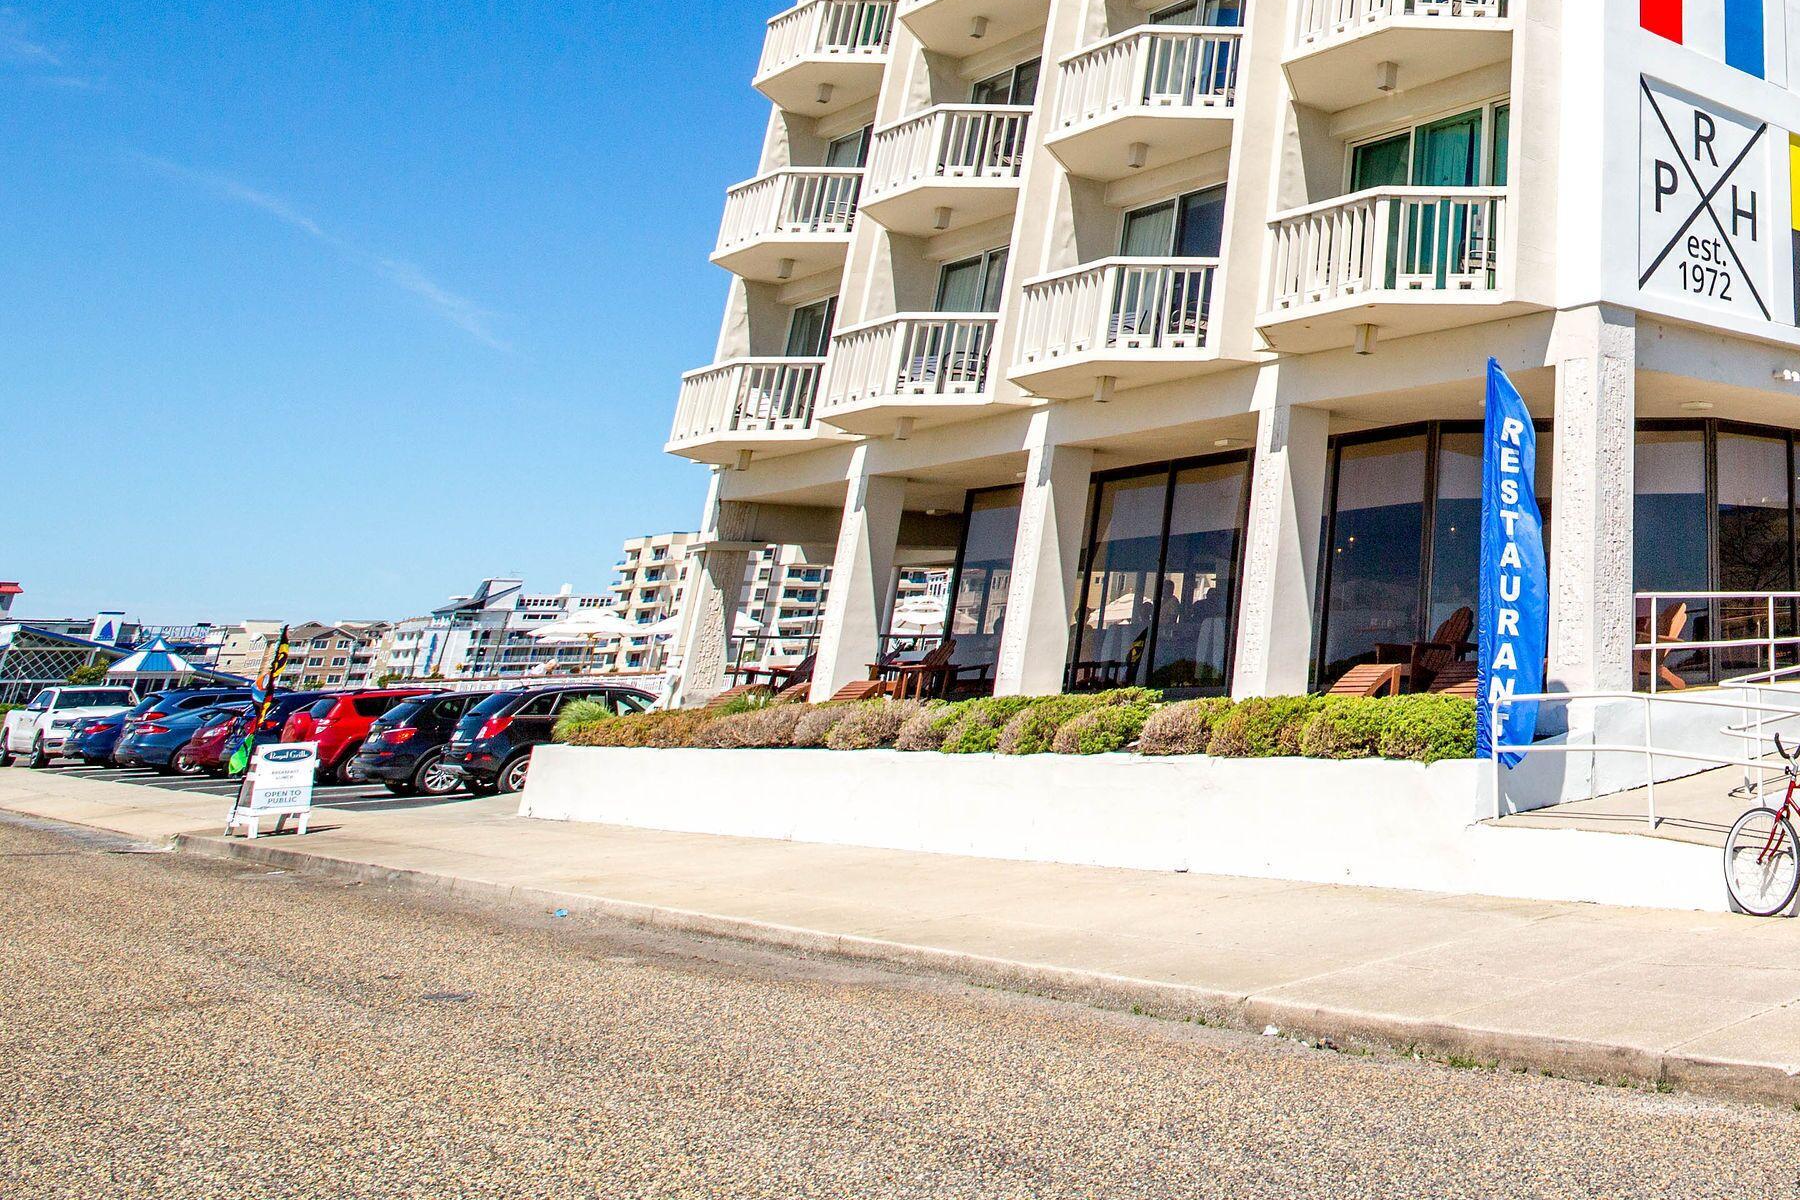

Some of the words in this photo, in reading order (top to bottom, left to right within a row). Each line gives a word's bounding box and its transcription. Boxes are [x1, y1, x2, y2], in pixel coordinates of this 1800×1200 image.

[1693, 109, 1719, 168] R
[1654, 158, 1679, 214] P
[1731, 184, 1758, 242] H
[1686, 234, 1728, 267] est.
[1678, 261, 1733, 302] 1972
[269, 750, 289, 761] Royal
[264, 790, 288, 798] OPEN
[267, 796, 298, 804] PUBLIC
